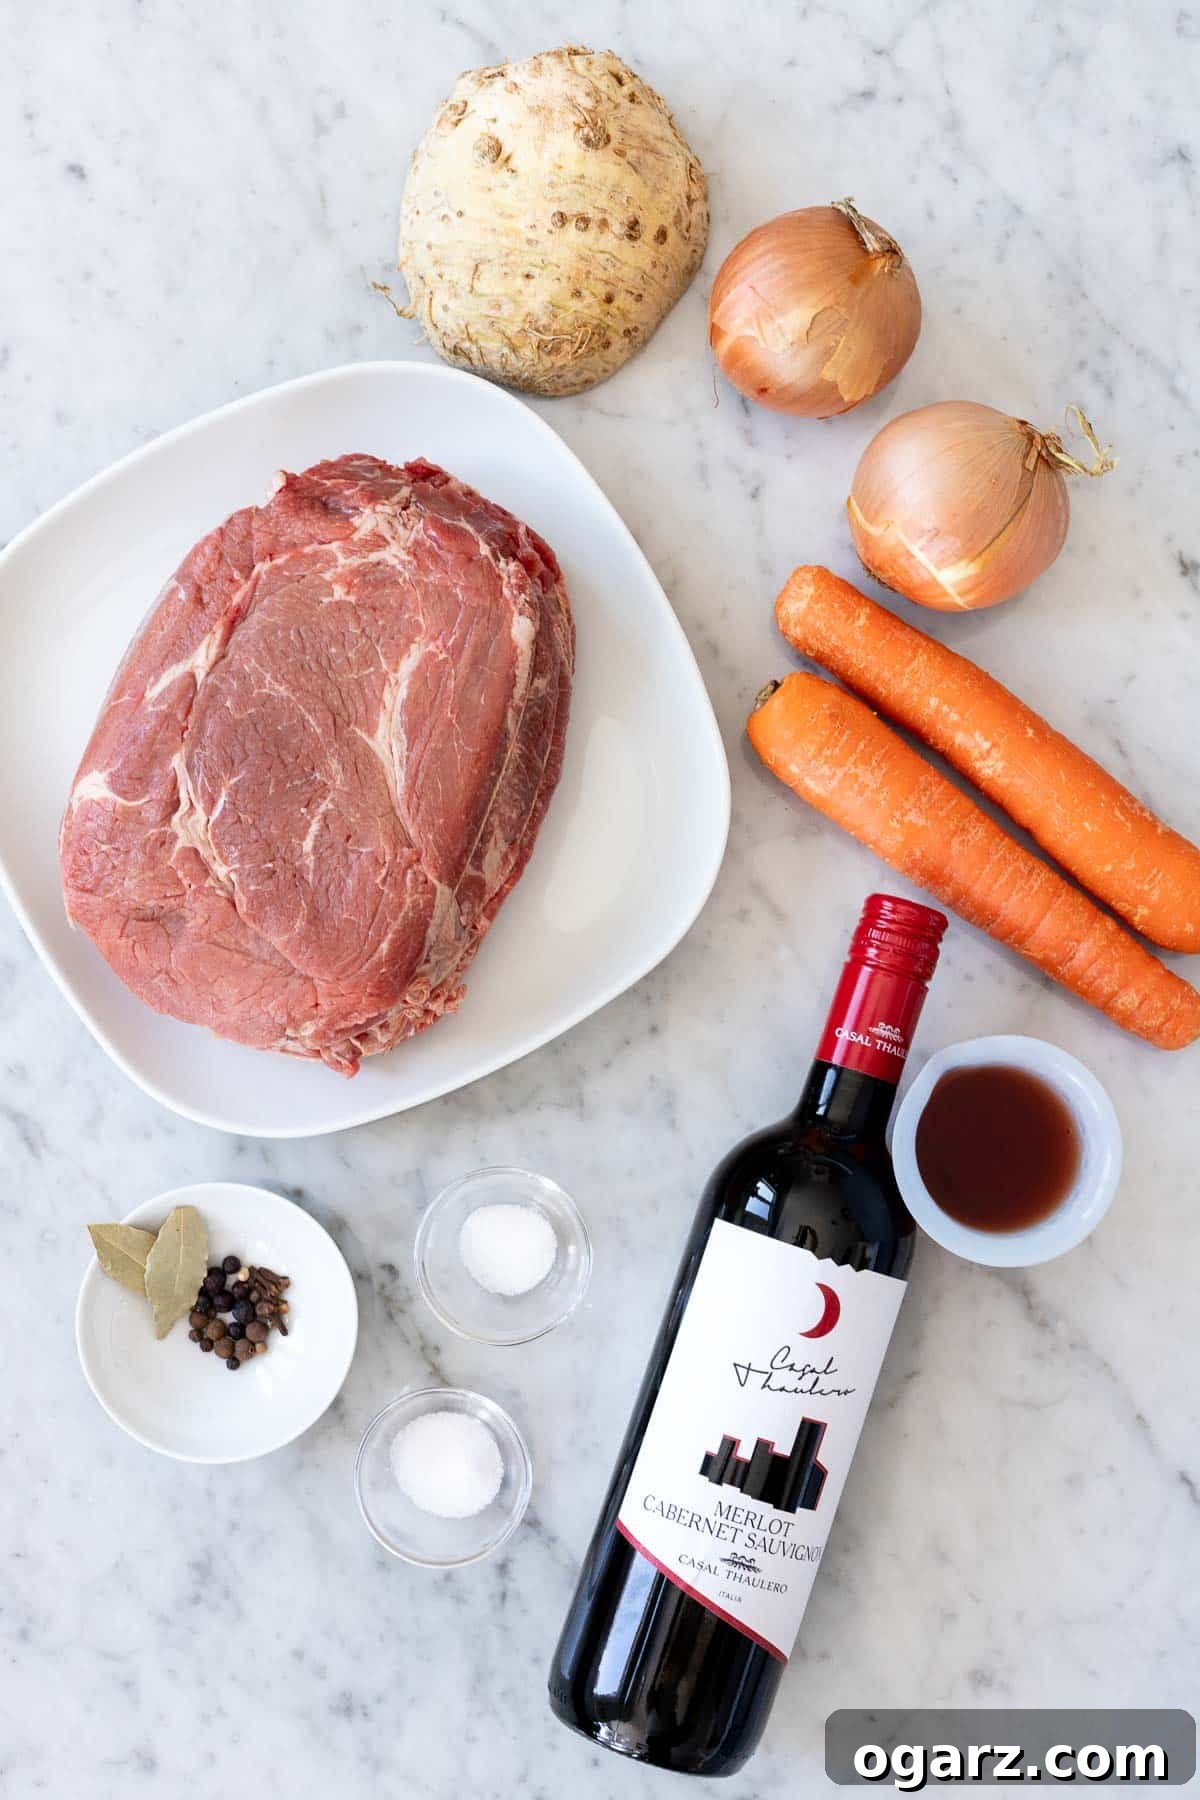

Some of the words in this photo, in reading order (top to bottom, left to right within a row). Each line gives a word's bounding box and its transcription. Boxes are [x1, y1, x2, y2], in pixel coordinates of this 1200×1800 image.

[834, 1027, 871, 1047] CASAL
[733, 1362, 856, 1397] Thaulero
[770, 1345, 838, 1380] Casal
[643, 1495, 744, 1544] CABERNET
[713, 1500, 795, 1537] MERLOT
[678, 1554, 720, 1577] CASAL
[725, 1568, 788, 1595] THAULERO
[718, 1590, 742, 1603] ITALIA
